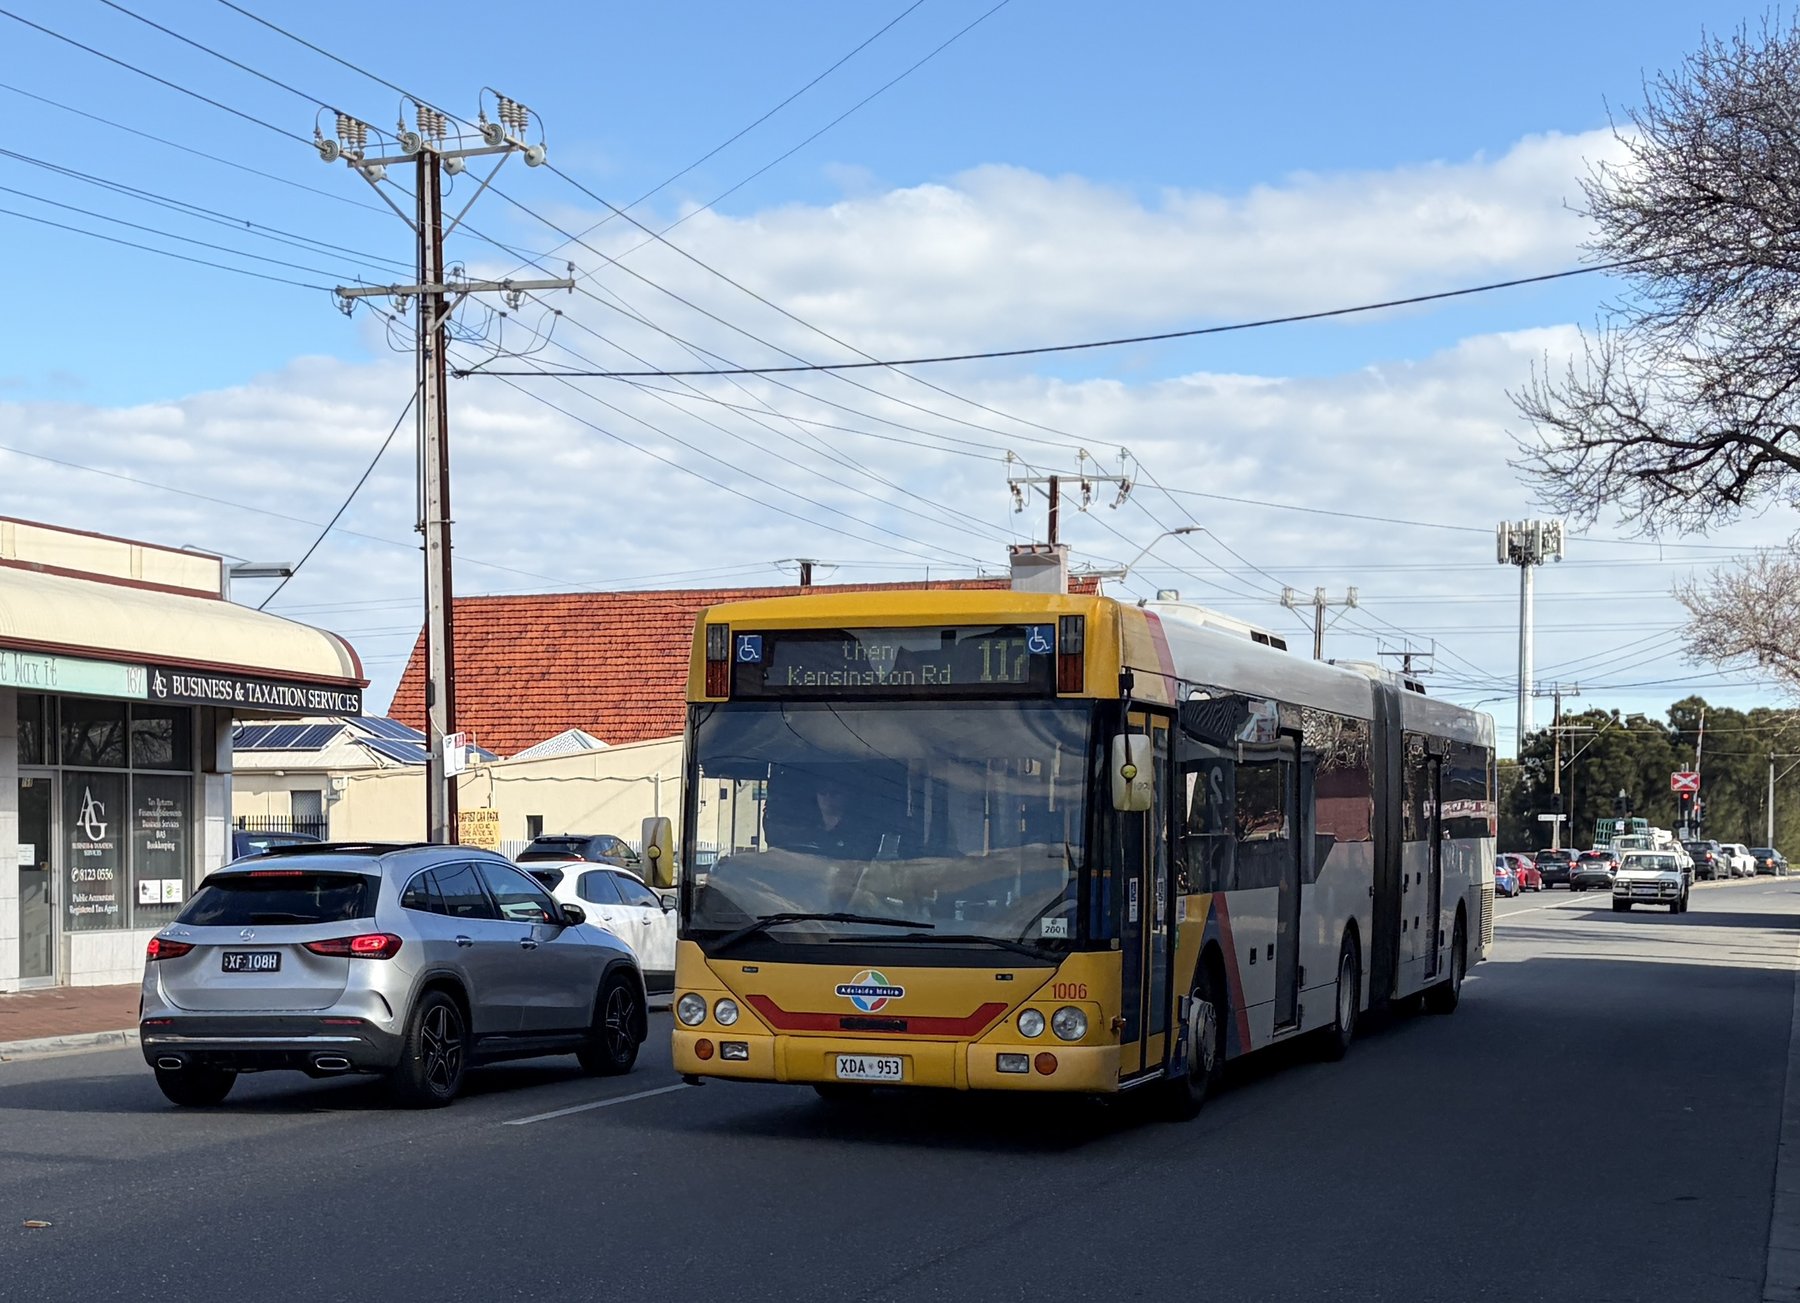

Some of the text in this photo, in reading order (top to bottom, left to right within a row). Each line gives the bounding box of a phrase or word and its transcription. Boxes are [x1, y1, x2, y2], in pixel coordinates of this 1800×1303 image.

[842, 639, 894, 661] then
[14, 653, 39, 685] Wax
[44, 658, 58, 687] it
[126, 667, 143, 694] 167
[788, 664, 951, 686] Kensington Rd
[172, 675, 233, 700] BUSINESS
[234, 683, 245, 701] &
[246, 683, 307, 708] TAXATION
[308, 690, 359, 712] SERVICES
[76, 786, 108, 841] AG
[79, 868, 96, 881] 8123
[840, 987, 900, 996] Adelaide Metro
[1051, 982, 1088, 999] 1006
[840, 1058, 900, 1075] XDA 953
